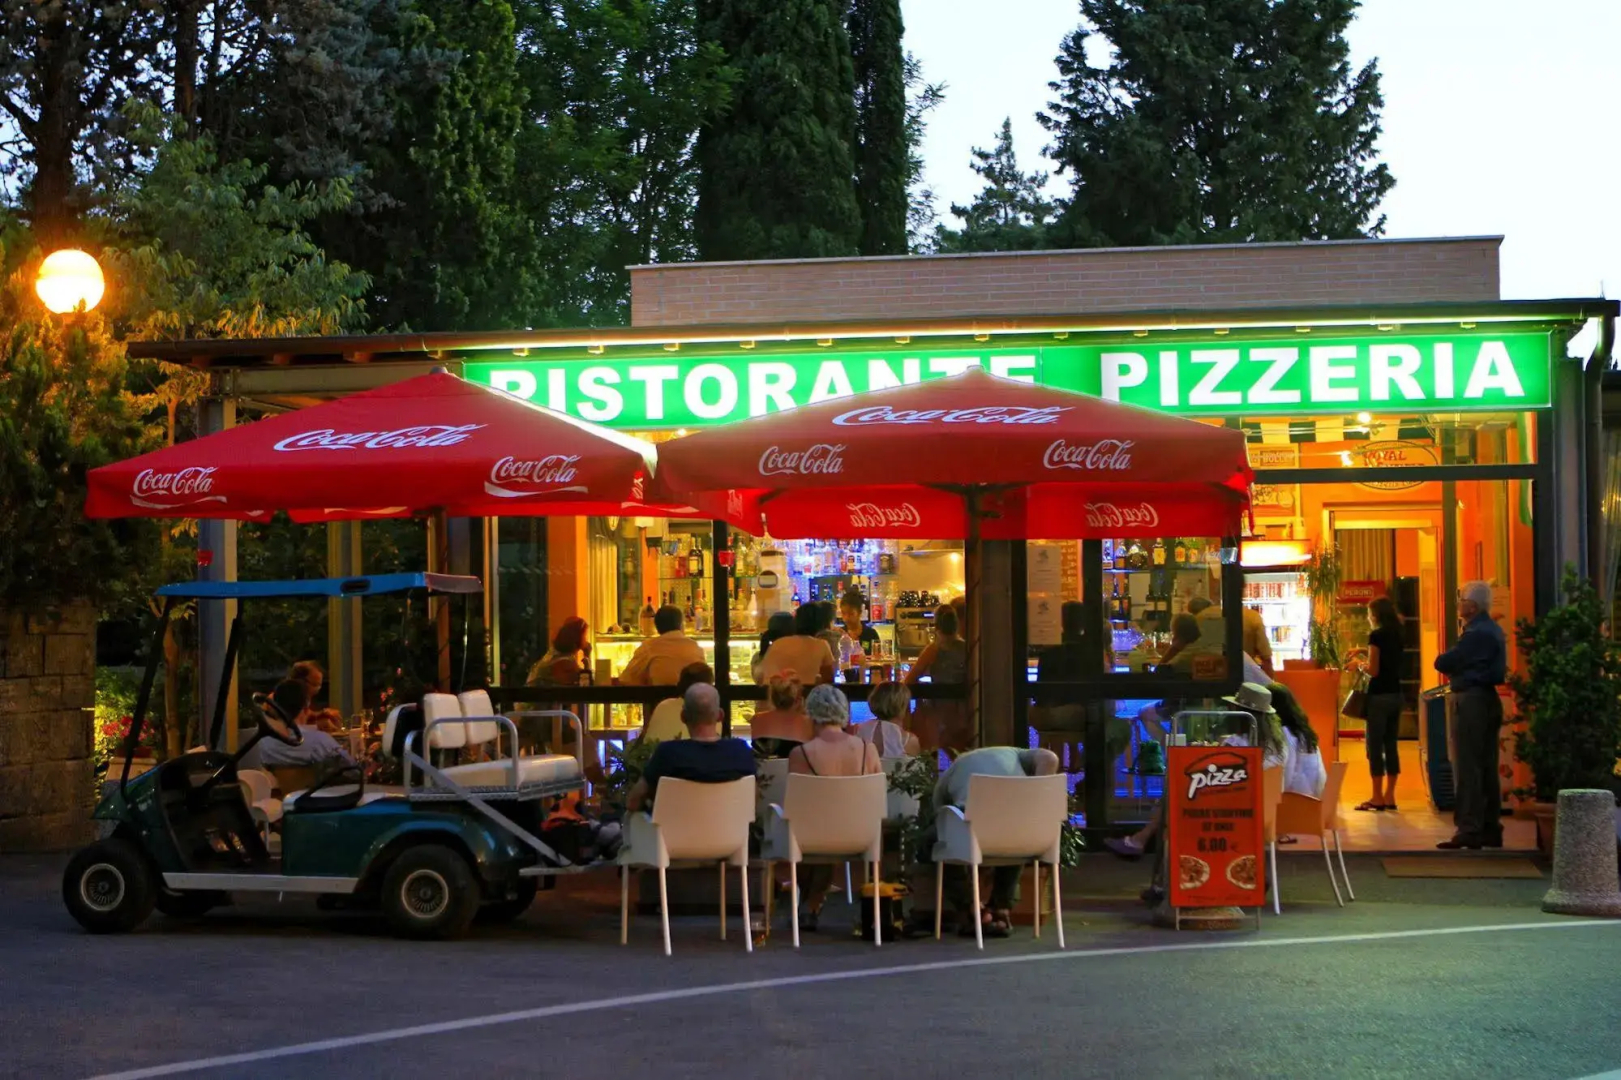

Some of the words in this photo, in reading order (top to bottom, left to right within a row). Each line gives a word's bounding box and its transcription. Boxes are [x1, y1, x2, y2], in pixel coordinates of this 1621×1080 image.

[1100, 341, 1525, 406] PIZZERIA
[490, 454, 582, 484] Coca-Cola
[758, 444, 847, 475] Coca-Cola
[1043, 439, 1135, 470] Coca-Cola
[133, 466, 219, 497] Coca-Cola
[1188, 763, 1247, 799] pizza
